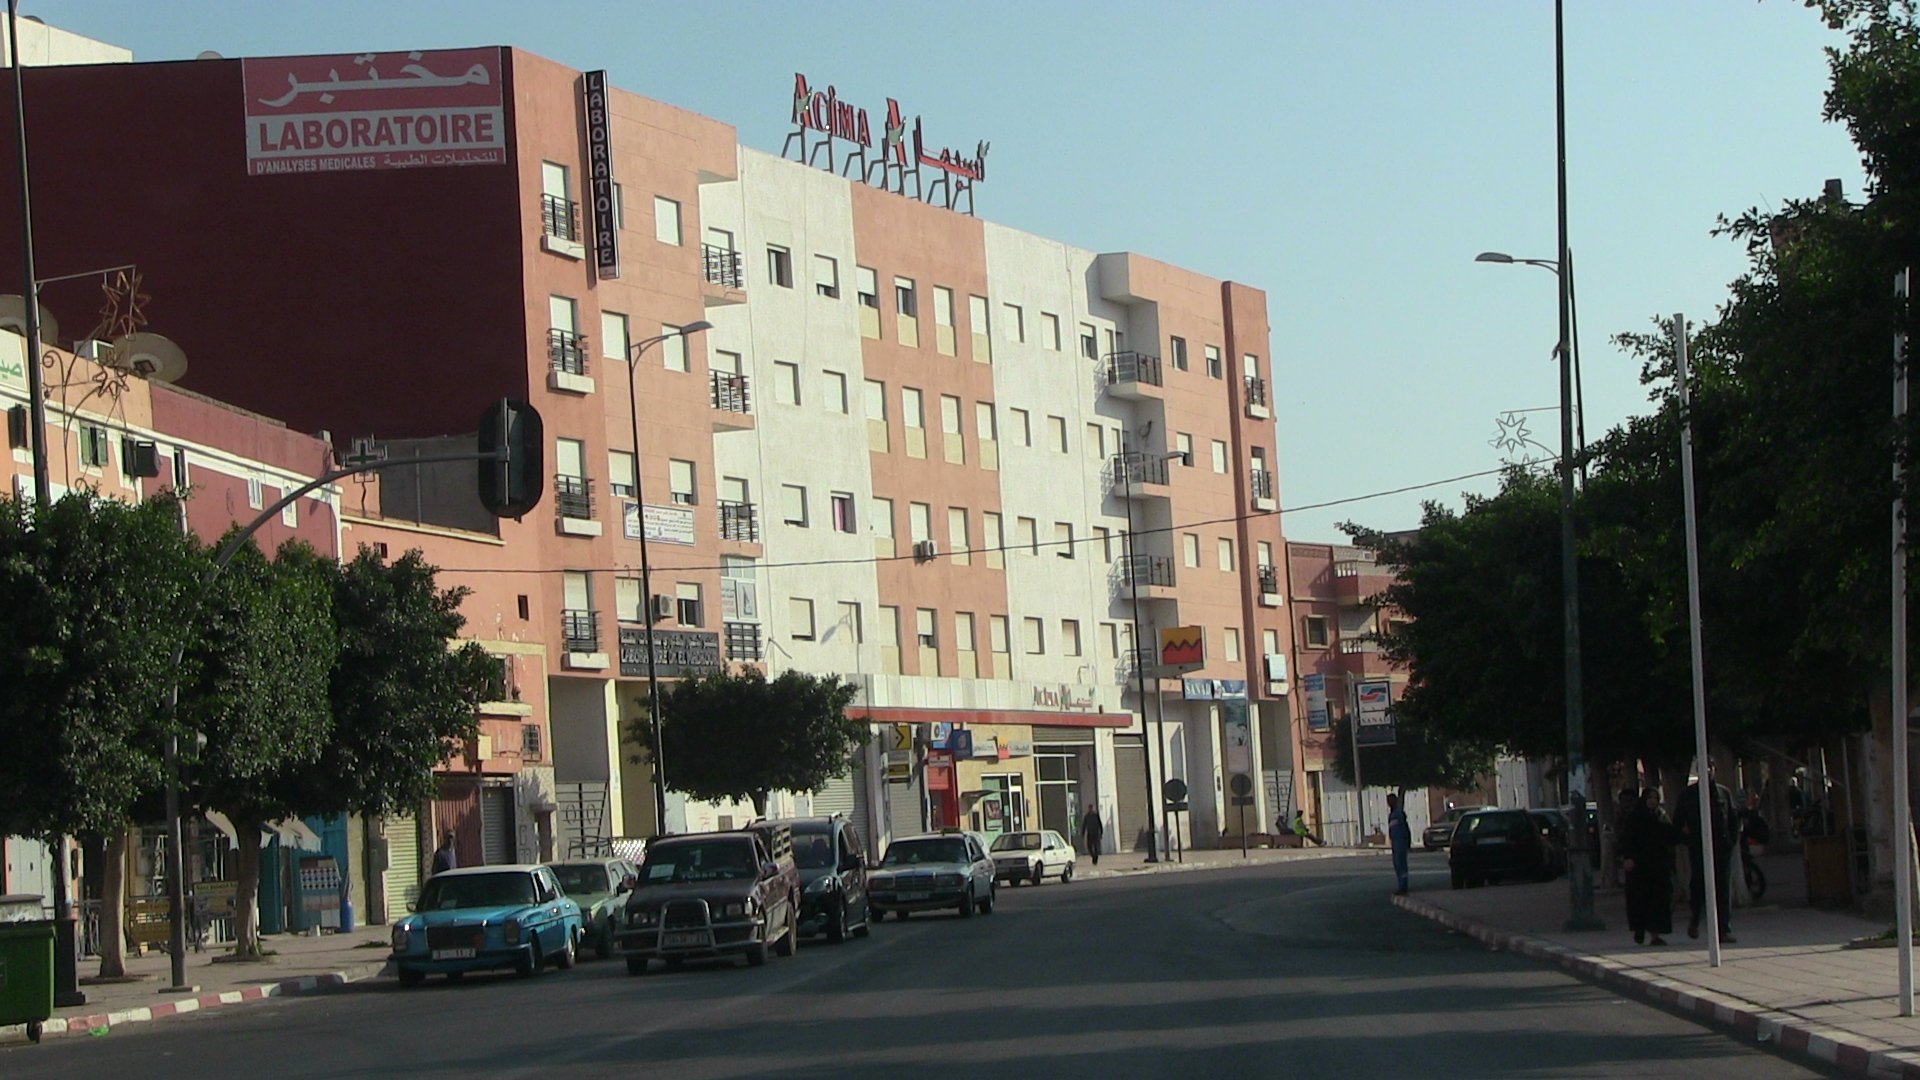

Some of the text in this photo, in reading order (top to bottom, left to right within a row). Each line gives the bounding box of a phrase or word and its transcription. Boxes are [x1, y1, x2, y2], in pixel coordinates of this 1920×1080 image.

[258, 51, 490, 107] مختبر
[259, 113, 494, 152] LABORATOIRE
[257, 156, 376, 173] D'ANALYSES MEDICALES
[590, 74, 612, 264] LABORATOIRE
